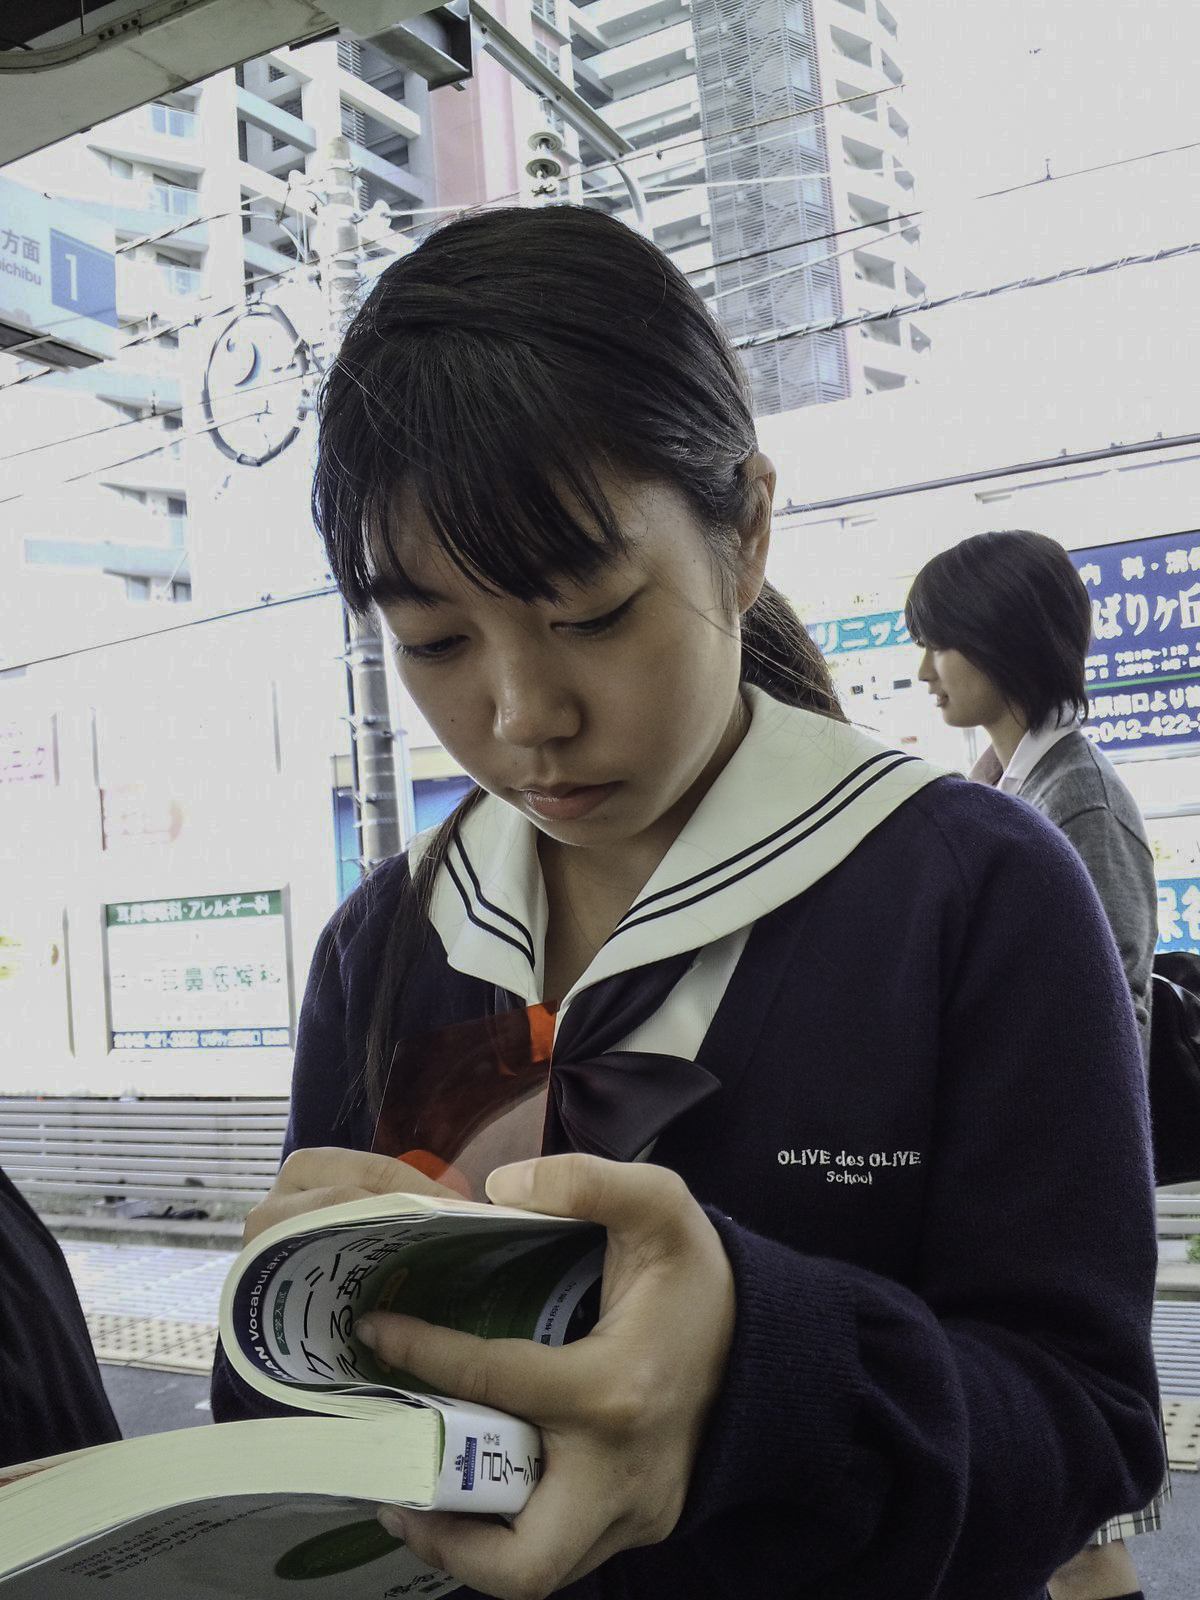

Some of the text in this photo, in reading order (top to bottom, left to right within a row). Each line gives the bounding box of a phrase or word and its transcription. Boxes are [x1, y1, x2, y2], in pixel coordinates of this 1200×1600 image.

[1, 229, 41, 265] 方面
[64, 253, 78, 302] 1
[1099, 711, 1200, 744] 042-422-
[777, 1149, 921, 1167] OLIVE des OLIVE
[826, 1170, 873, 1185] School
[249, 1250, 289, 1342] Vocabulary
